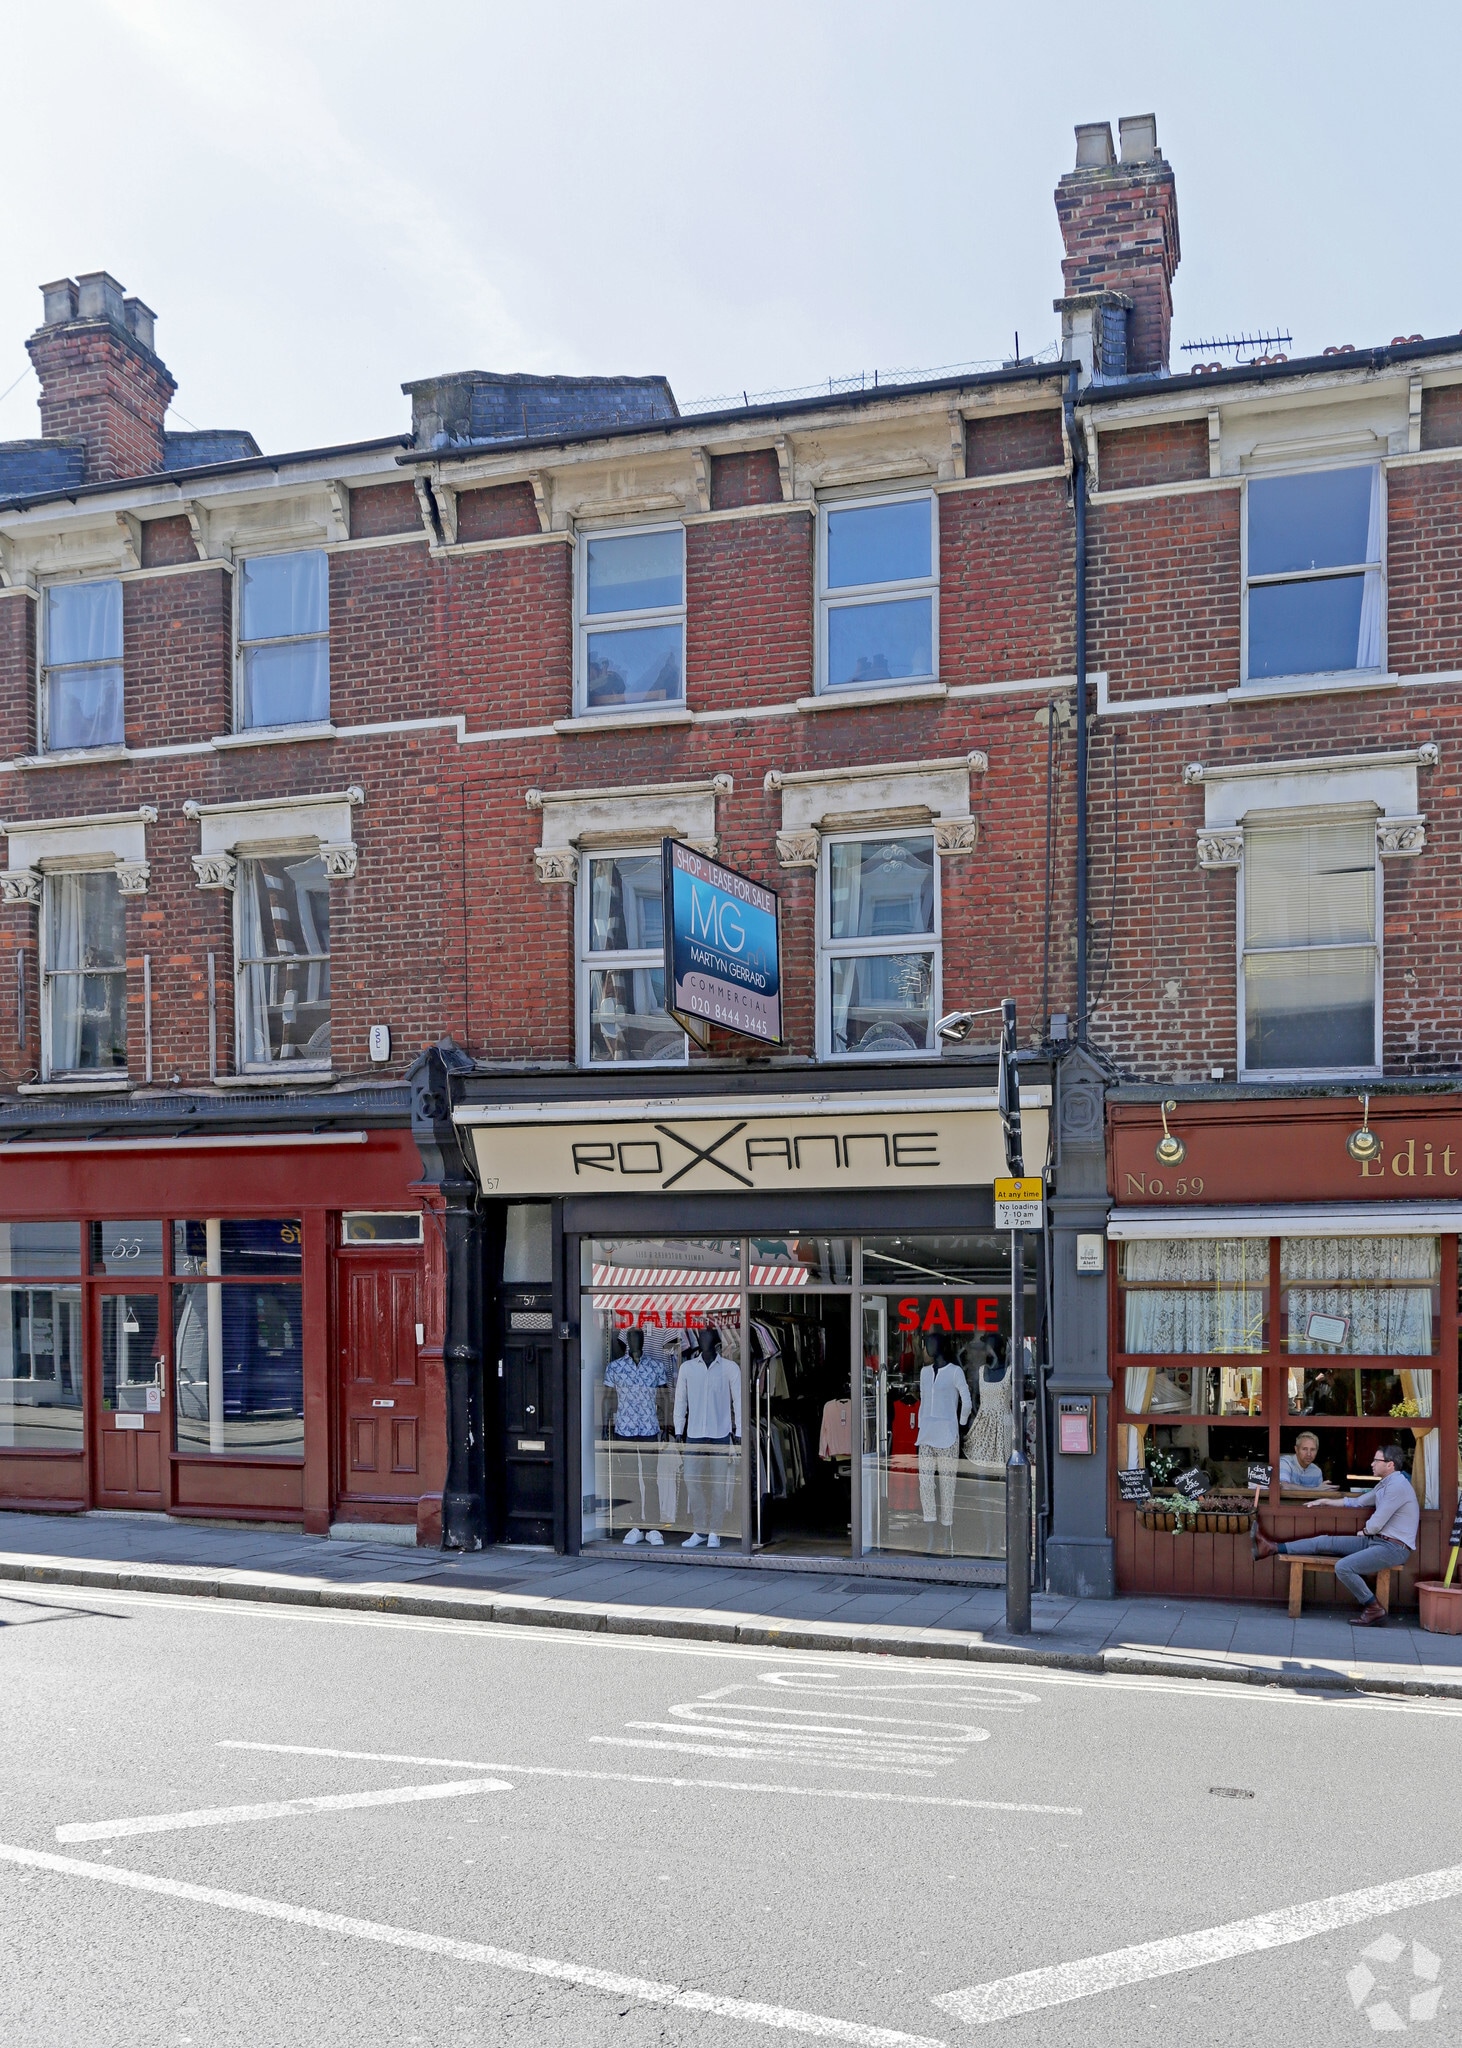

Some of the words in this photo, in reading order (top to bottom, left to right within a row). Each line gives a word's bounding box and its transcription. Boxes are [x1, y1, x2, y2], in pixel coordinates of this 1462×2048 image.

[677, 849, 702, 875] SHOP
[708, 866, 733, 894] LEASE
[734, 878, 751, 902] FOR
[751, 887, 770, 913] SALE
[690, 884, 745, 953] MG
[690, 946, 728, 974] MARTYN
[729, 961, 766, 989] GERRARD
[690, 976, 767, 1014] COMMERCIAL
[690, 995, 710, 1014] 020
[714, 1004, 740, 1025] 8444
[744, 1014, 767, 1035] 3445
[487, 1177, 500, 1190] 57
[1125, 1173, 1169, 1196] No.
[1176, 1176, 1204, 1196] 59
[111, 1238, 144, 1259] 55
[523, 1295, 535, 1306] 57
[898, 1298, 999, 1332] SALE
[1253, 1465, 1266, 1475] dog
